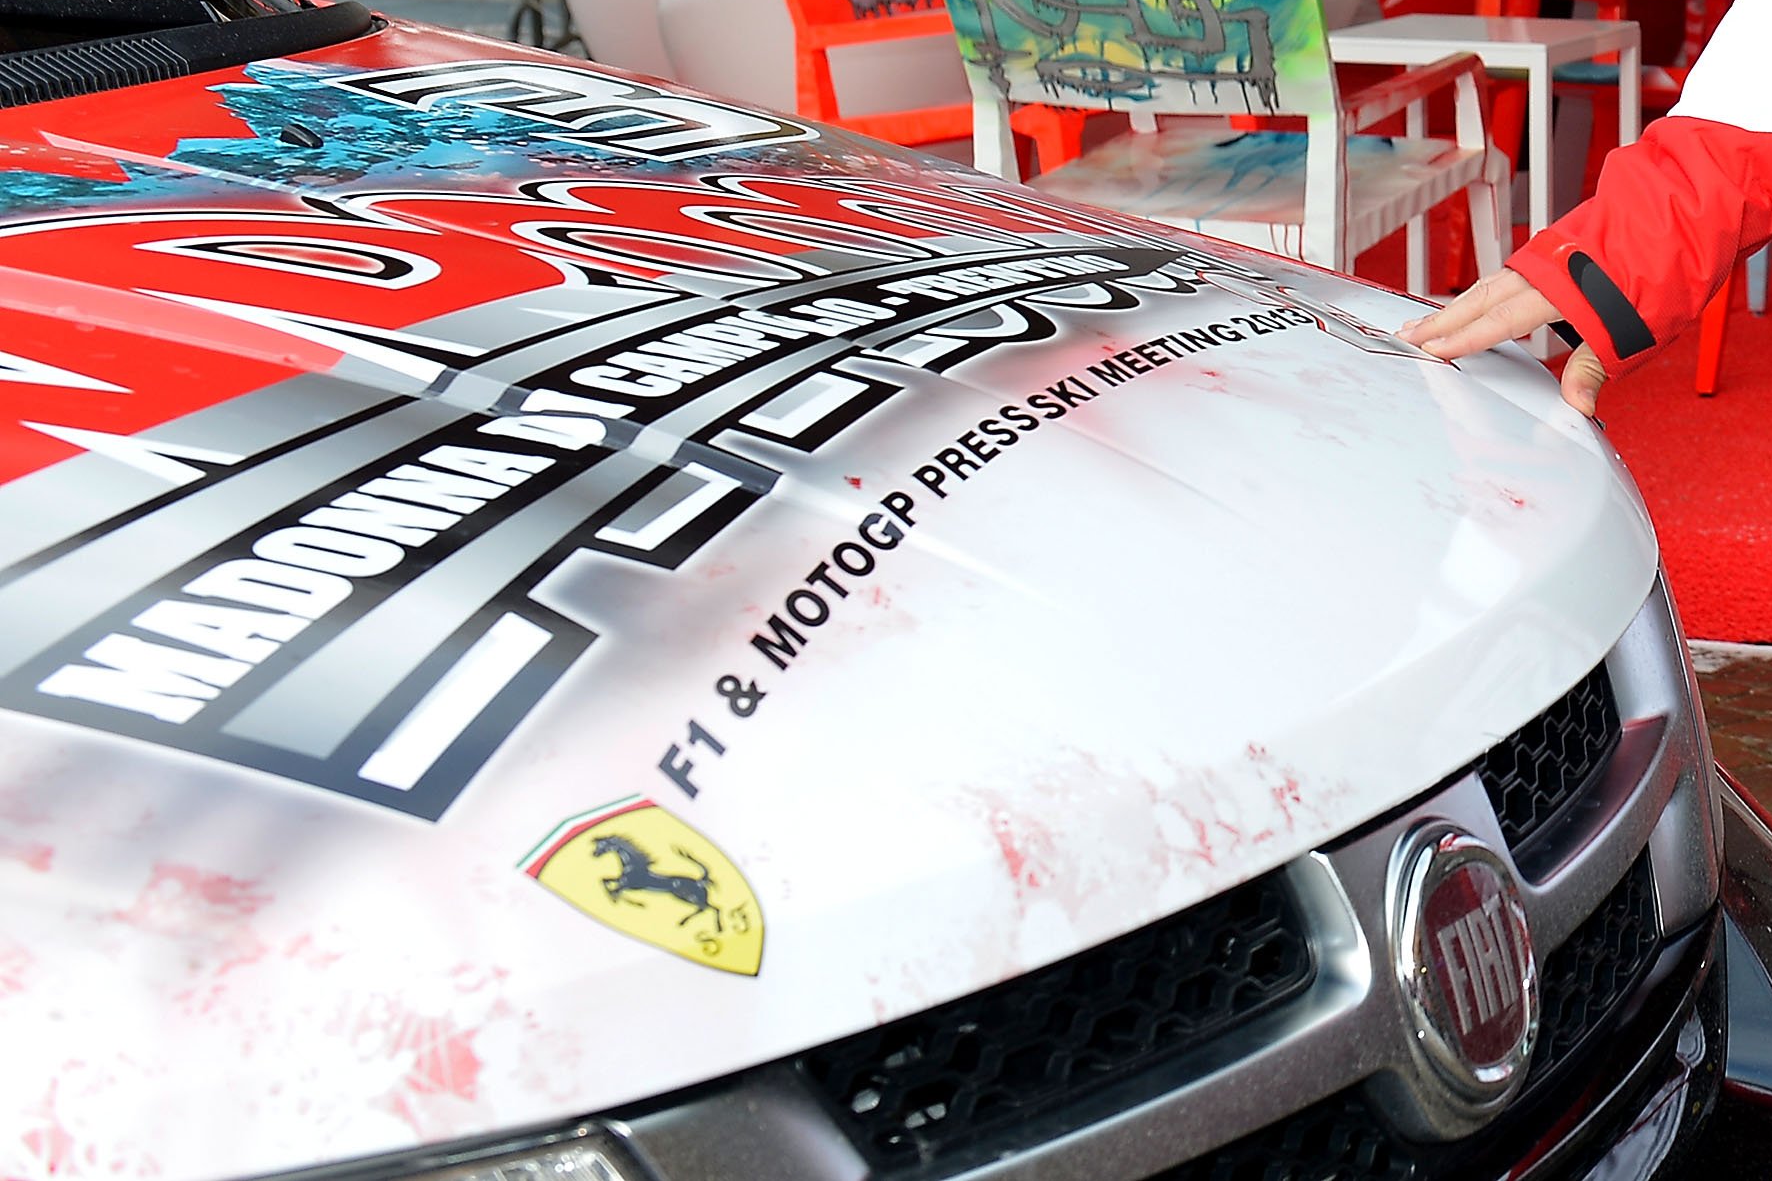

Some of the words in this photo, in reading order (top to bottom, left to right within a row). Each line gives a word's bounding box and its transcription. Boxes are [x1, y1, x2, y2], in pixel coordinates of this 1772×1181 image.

[36, 442, 557, 725] MADONNA
[477, 387, 636, 452] DI
[876, 254, 1131, 302] TRENTINO
[657, 718, 727, 801] F1
[716, 673, 767, 719] &
[750, 491, 917, 673] MOTOGP
[1086, 322, 1247, 388] MEETING
[1230, 307, 1314, 336] 2013
[1436, 892, 1520, 1036] FIAT
